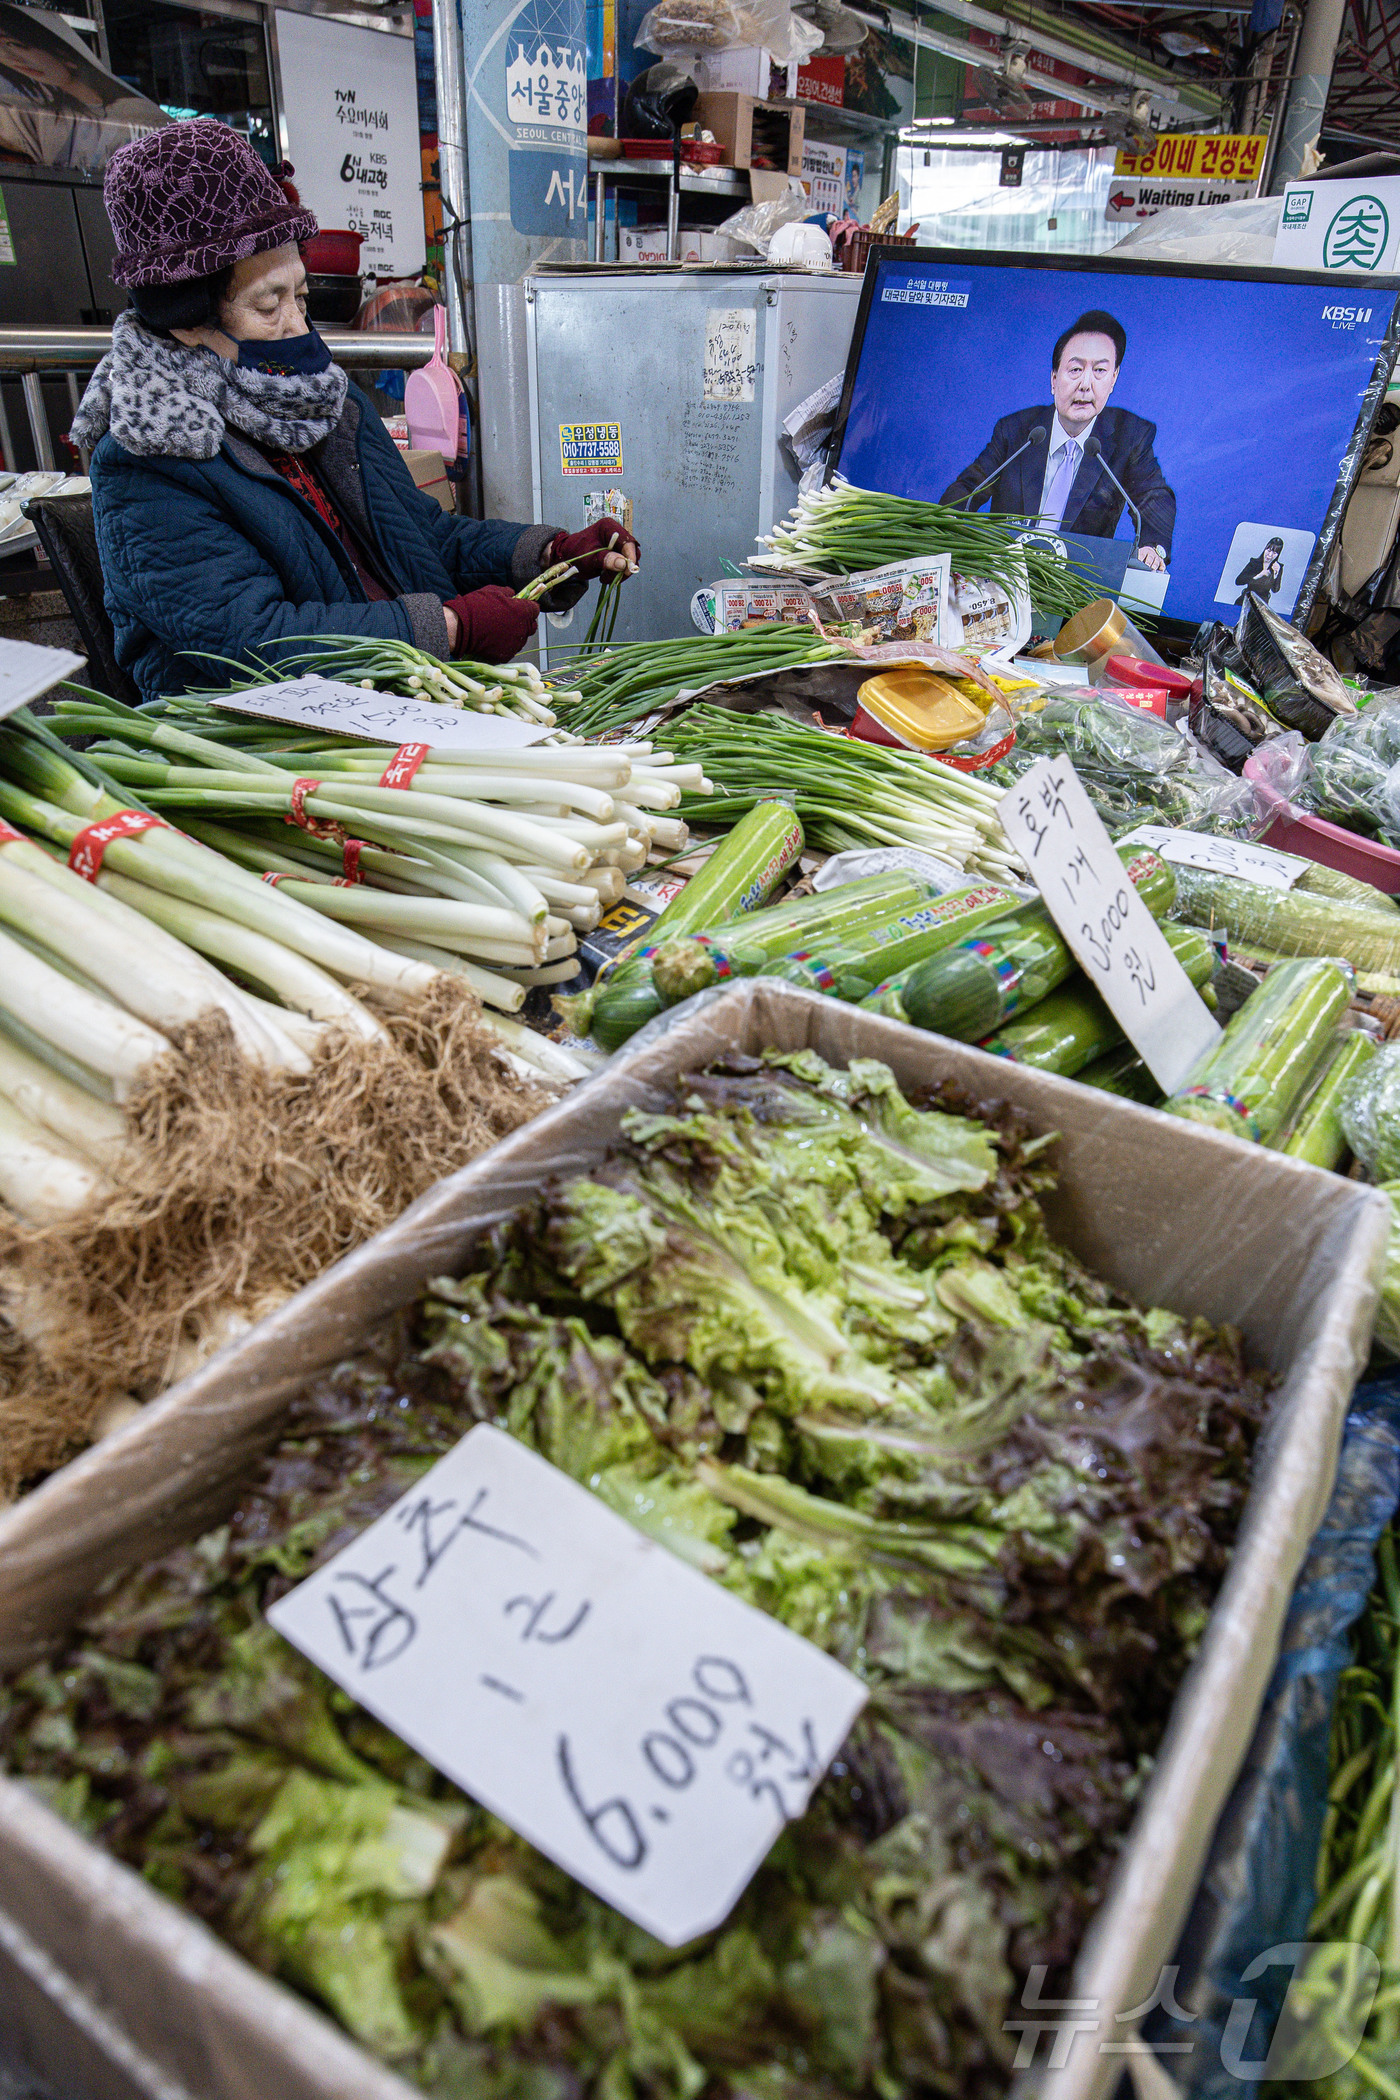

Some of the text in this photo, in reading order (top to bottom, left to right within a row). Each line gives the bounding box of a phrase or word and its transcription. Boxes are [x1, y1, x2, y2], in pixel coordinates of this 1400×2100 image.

[334, 89, 356, 103] tvN
[517, 128, 548, 140] SEOUL
[551, 131, 582, 144] CENTRAL
[370, 153, 387, 165] KBS
[1201, 140, 1260, 175] 건생선
[1139, 188, 1194, 206] Waiting
[1198, 190, 1231, 206] Line
[1290, 198, 1307, 206] GAP
[906, 278, 949, 292] 윤석열 대통령
[884, 290, 966, 306] 대국민 담화 및 기자회견
[1332, 321, 1356, 331] LIVE
[574, 425, 619, 439] 우성냉동
[1019, 774, 1073, 857] 호박
[1061, 846, 1101, 905] 1개
[1123, 947, 1156, 1006] 원
[325, 1489, 543, 1673] 상추
